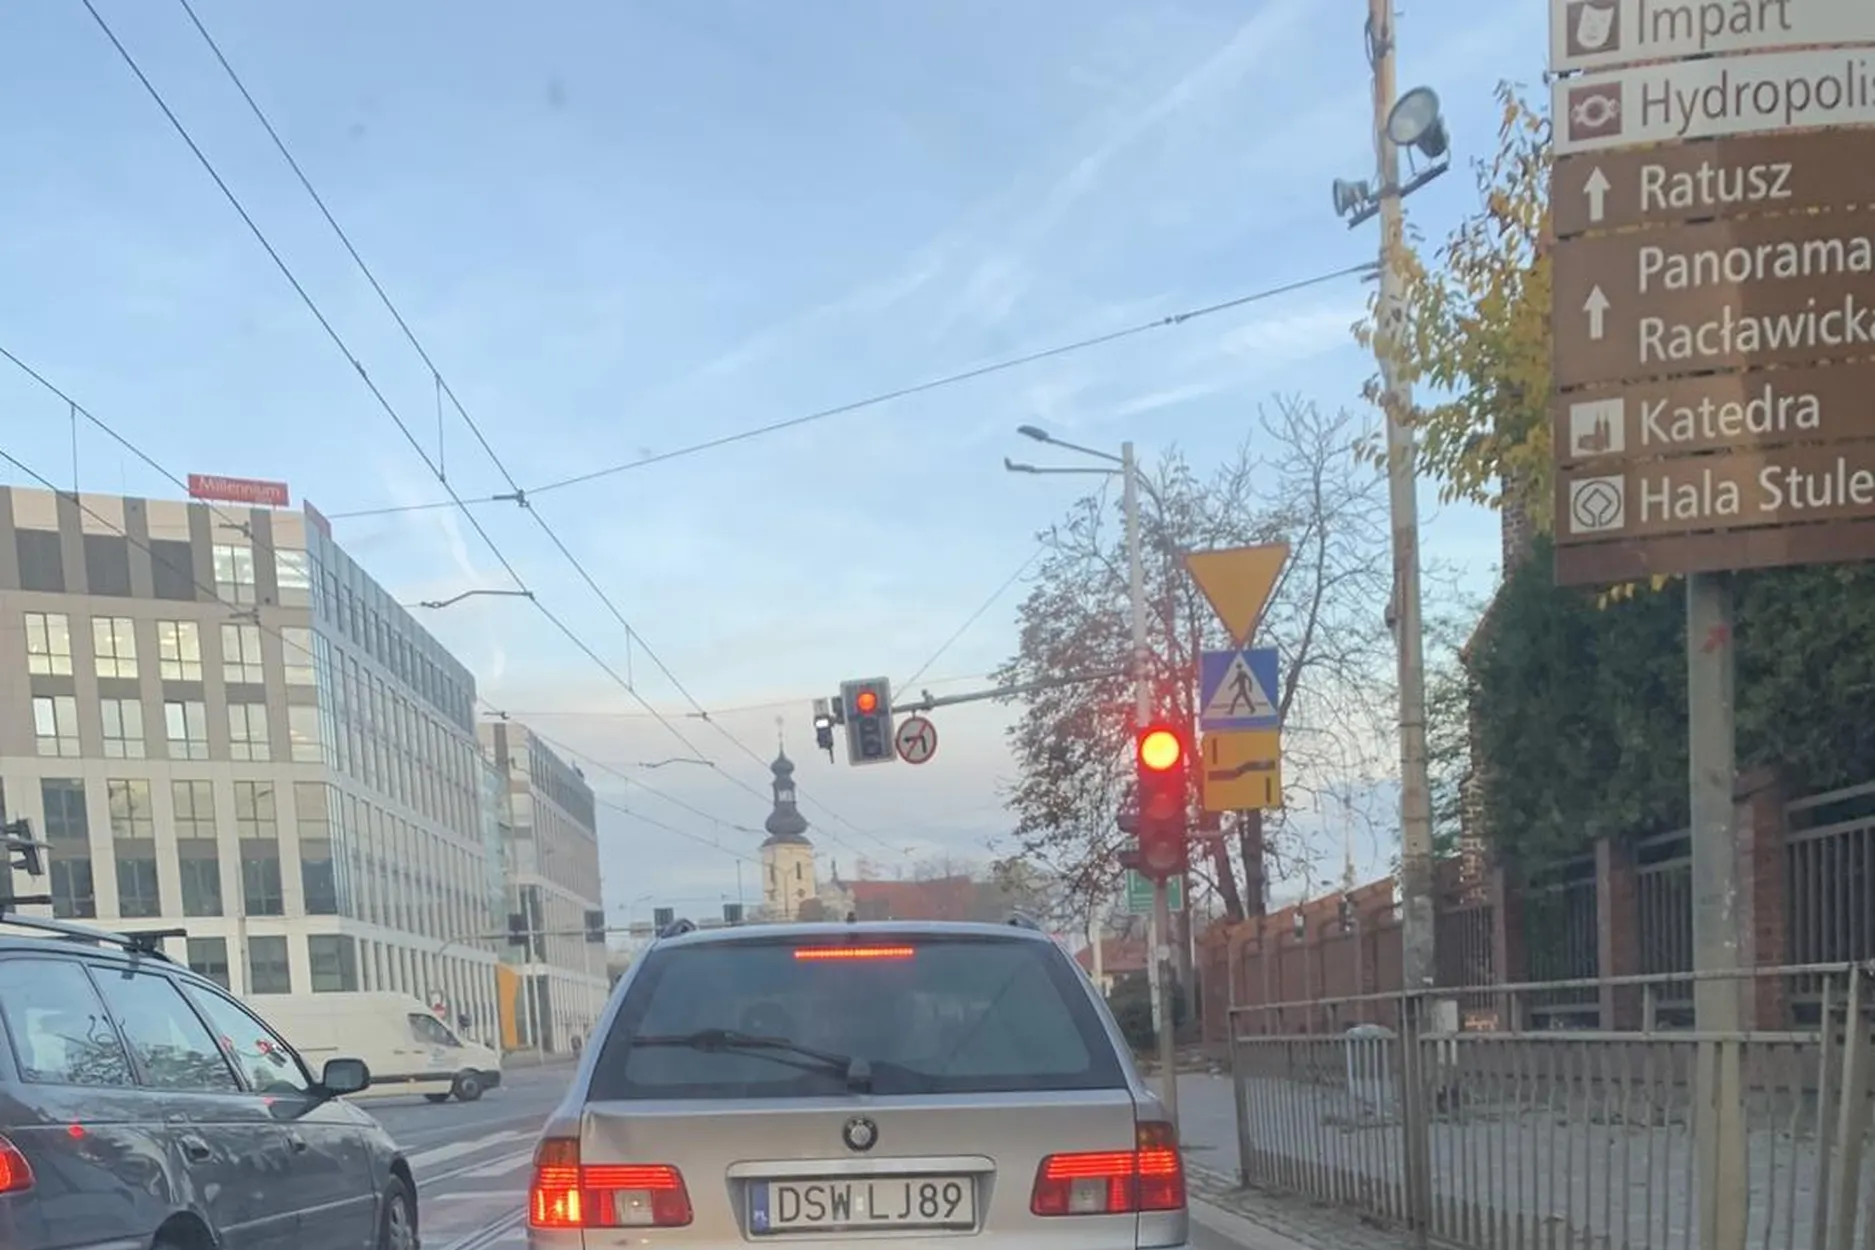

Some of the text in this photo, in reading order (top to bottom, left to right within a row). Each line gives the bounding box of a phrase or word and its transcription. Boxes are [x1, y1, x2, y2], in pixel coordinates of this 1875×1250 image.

[1638, 0, 1792, 50] Impart
[1642, 60, 1875, 136] Hydropoli
[1640, 160, 1793, 211] Ratusz
[1639, 236, 1872, 293] Panorama
[1639, 293, 1875, 364] Racławick
[1641, 383, 1820, 445] Katedra
[1641, 468, 1740, 522] Hala
[778, 1182, 962, 1223] DSW LJ89
